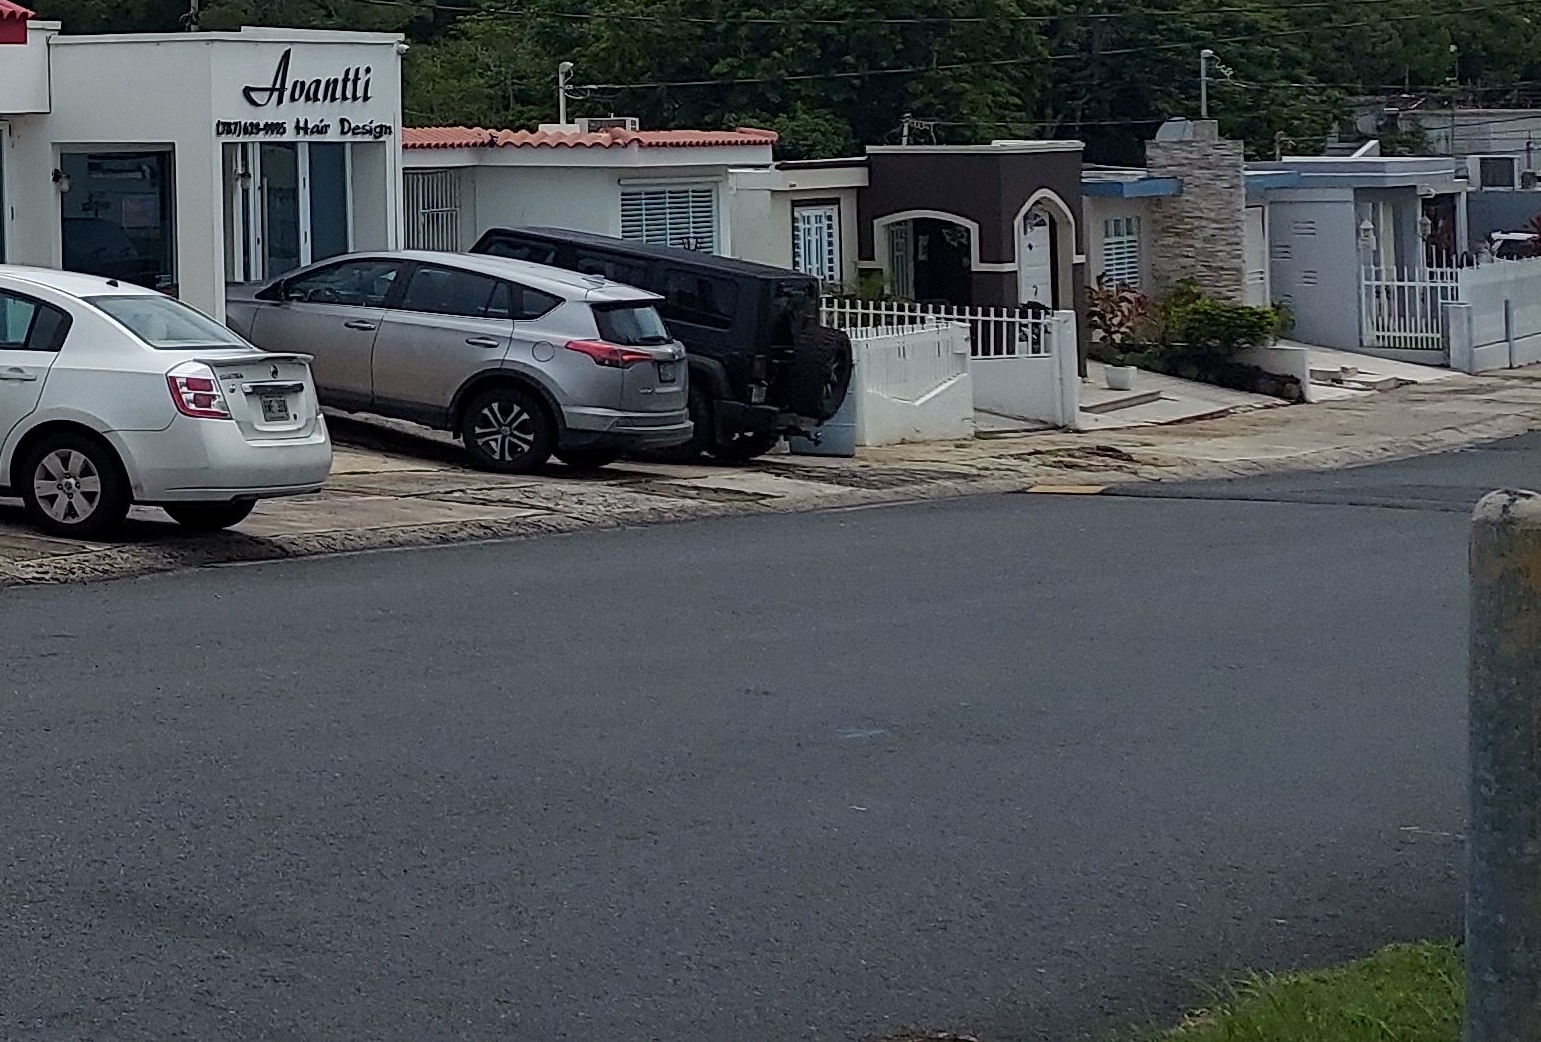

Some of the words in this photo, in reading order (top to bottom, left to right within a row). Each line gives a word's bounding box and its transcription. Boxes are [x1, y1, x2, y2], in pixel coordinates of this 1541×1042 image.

[242, 47, 373, 107] Avantti
[294, 118, 331, 135] Hair
[339, 117, 393, 139] Design
